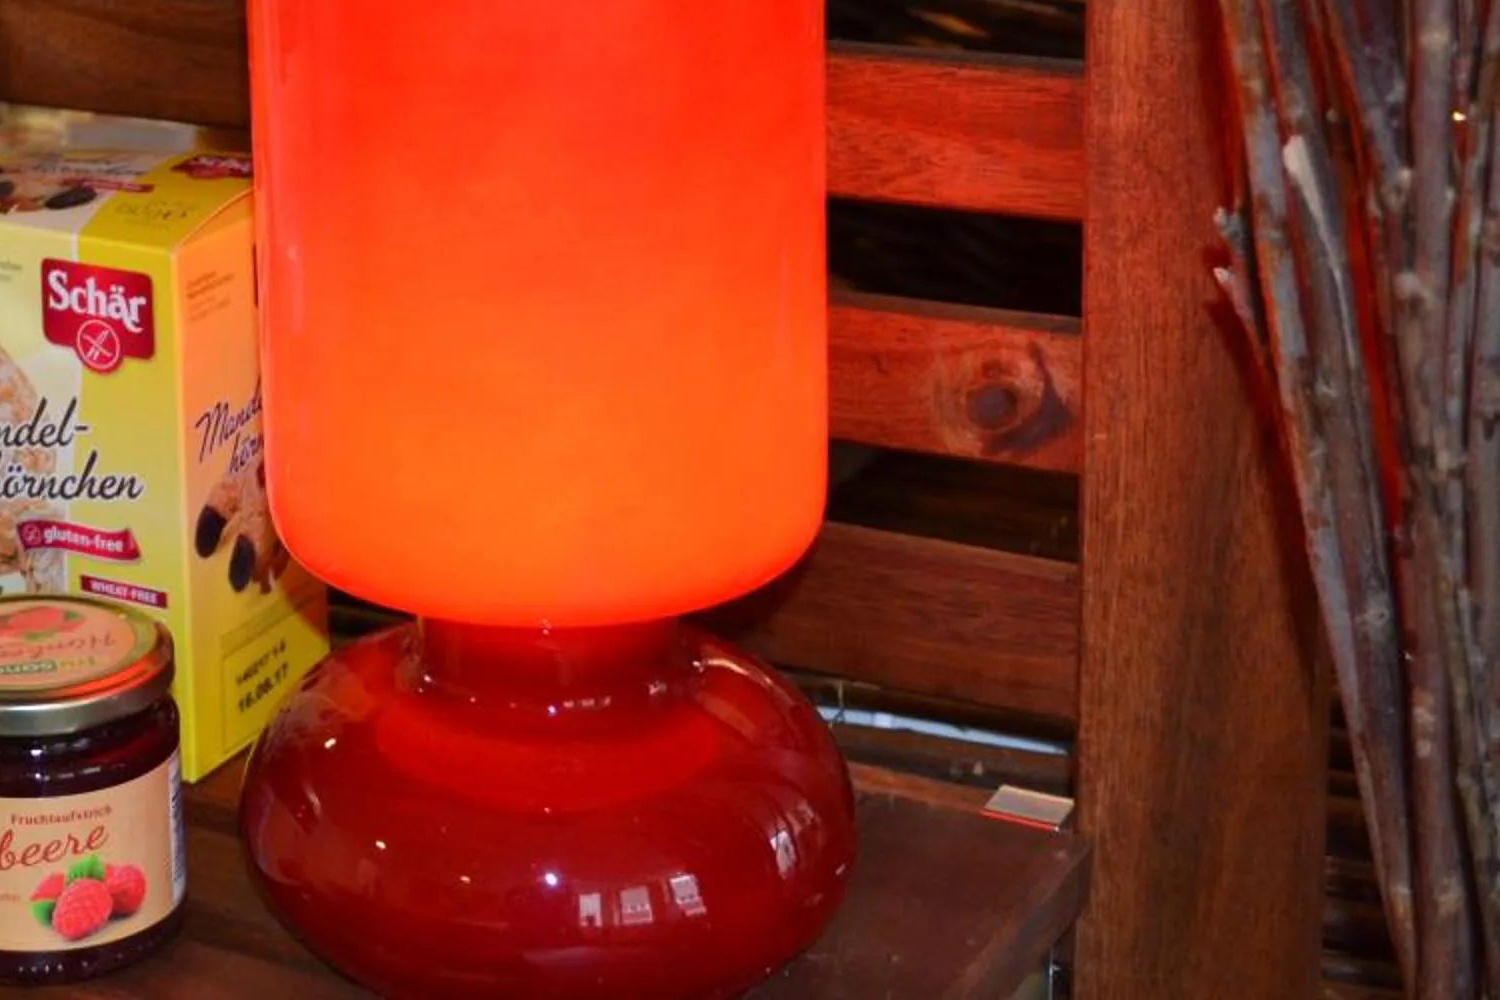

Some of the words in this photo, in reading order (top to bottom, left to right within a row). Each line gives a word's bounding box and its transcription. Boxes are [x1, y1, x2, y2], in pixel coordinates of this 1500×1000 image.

[47, 269, 148, 334] Schär
[44, 526, 125, 553] gluten-free
[10, 804, 112, 826] Fruchtaufstrich
